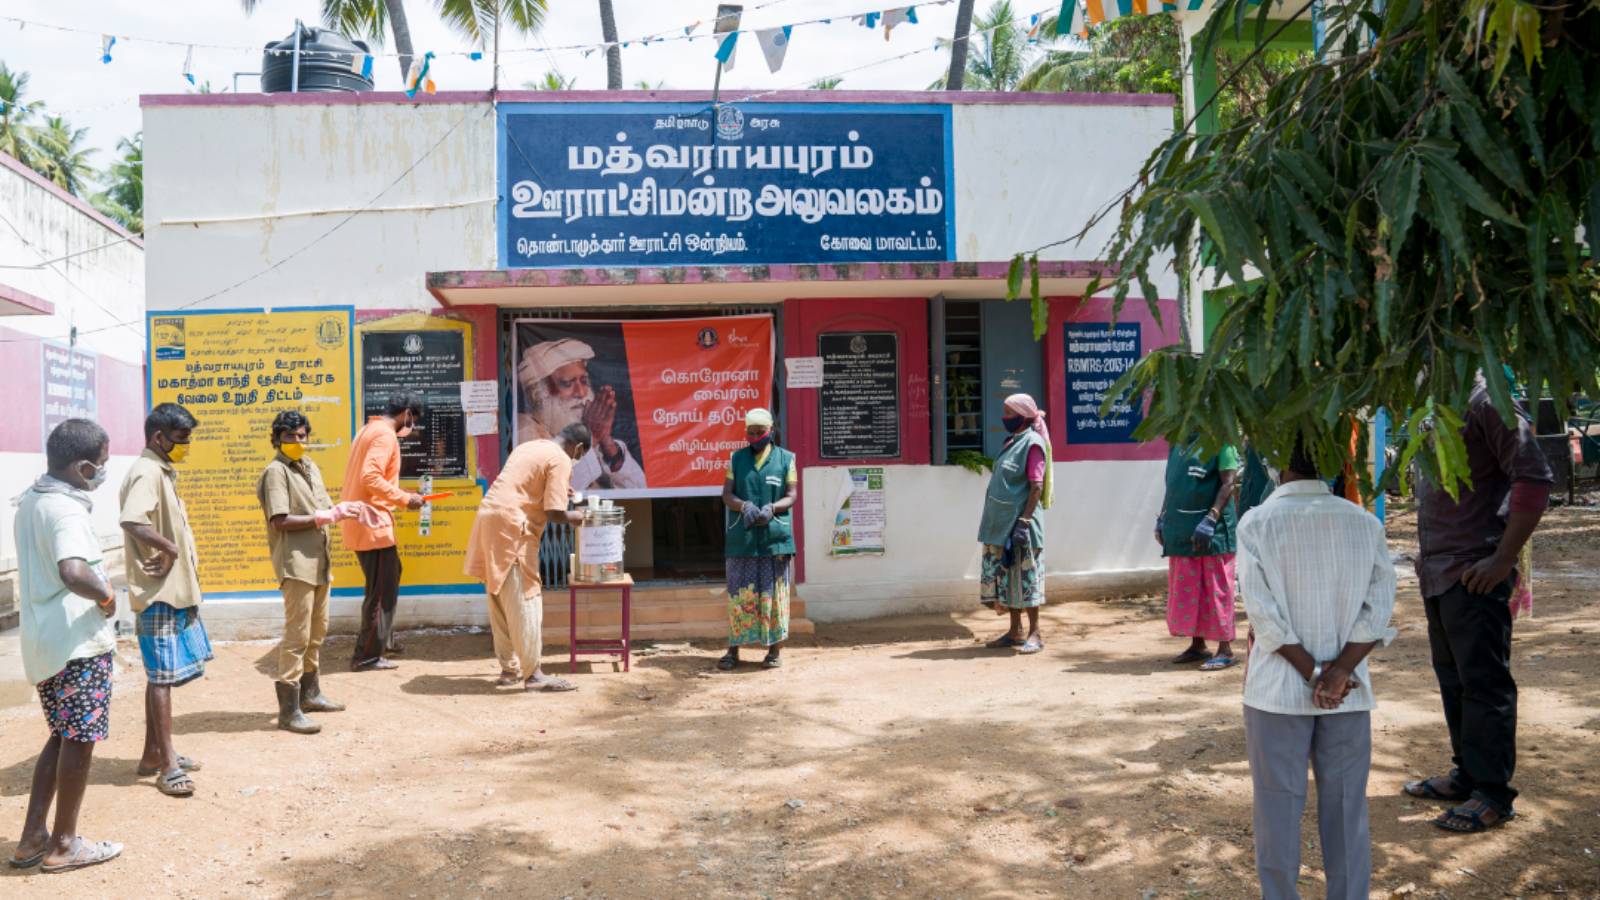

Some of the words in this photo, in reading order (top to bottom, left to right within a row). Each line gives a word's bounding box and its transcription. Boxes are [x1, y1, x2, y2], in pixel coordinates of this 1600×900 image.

[749, 117, 780, 131] அரசு
[568, 131, 874, 176] மத்வராயபுரம்
[628, 233, 682, 256] ஊராட்சி
[820, 234, 872, 252] கோவை
[876, 232, 943, 252] மாவட்டம்.
[275, 358, 324, 372] ஊராட்சி
[158, 374, 214, 390] மகாத்மா
[216, 372, 251, 388] காந்தி
[257, 373, 293, 386] தேசிய
[300, 373, 336, 387] ஊரக
[661, 368, 760, 386] கொரோனா
[177, 392, 218, 405] வேலை
[222, 389, 259, 406] உறுதி
[262, 387, 304, 404] திட்டம்
[693, 386, 759, 402] வைரஸ்
[652, 408, 704, 426] நோய்
[707, 406, 746, 427] தடுப்
[669, 438, 750, 456] விழிப்புணர்
[691, 457, 732, 472] பிரச்ச
